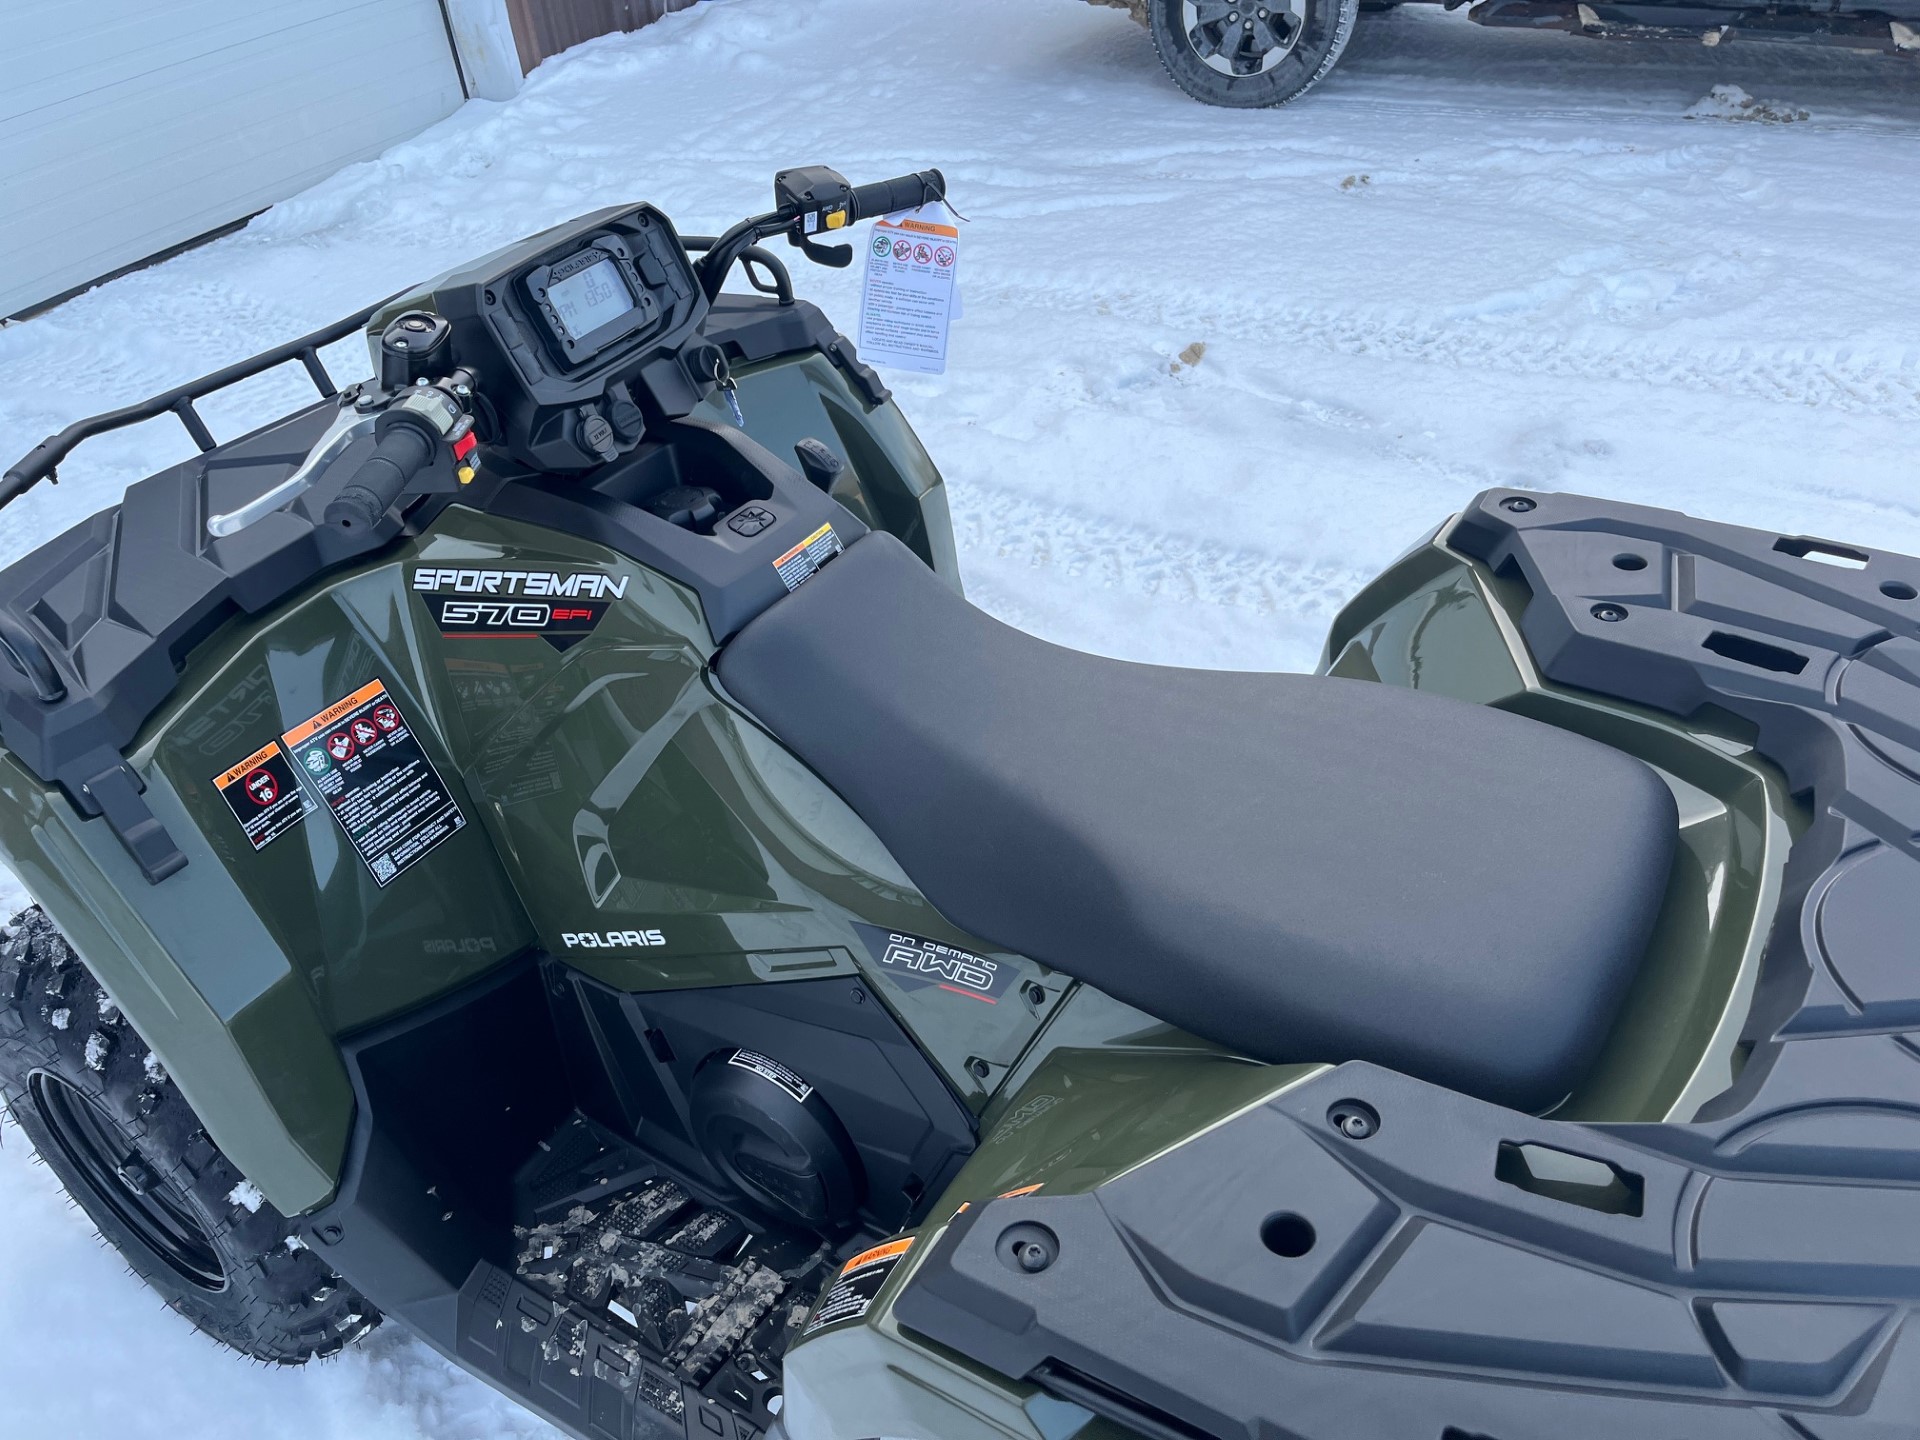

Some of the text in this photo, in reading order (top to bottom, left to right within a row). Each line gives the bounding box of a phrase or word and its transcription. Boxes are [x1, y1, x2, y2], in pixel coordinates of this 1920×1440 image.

[904, 222, 936, 232] WARNING
[413, 568, 629, 599] SPORTSMAN
[441, 602, 592, 626] 570 EFI
[320, 697, 357, 722] WARNING
[232, 750, 268, 776] WARNING
[248, 774, 270, 790] UNDER
[258, 787, 273, 802] 16
[561, 929, 666, 948] POLARIS
[889, 933, 997, 971] ON DEMAND
[883, 944, 993, 990] AWD
[764, 1068, 777, 1079] STEP
